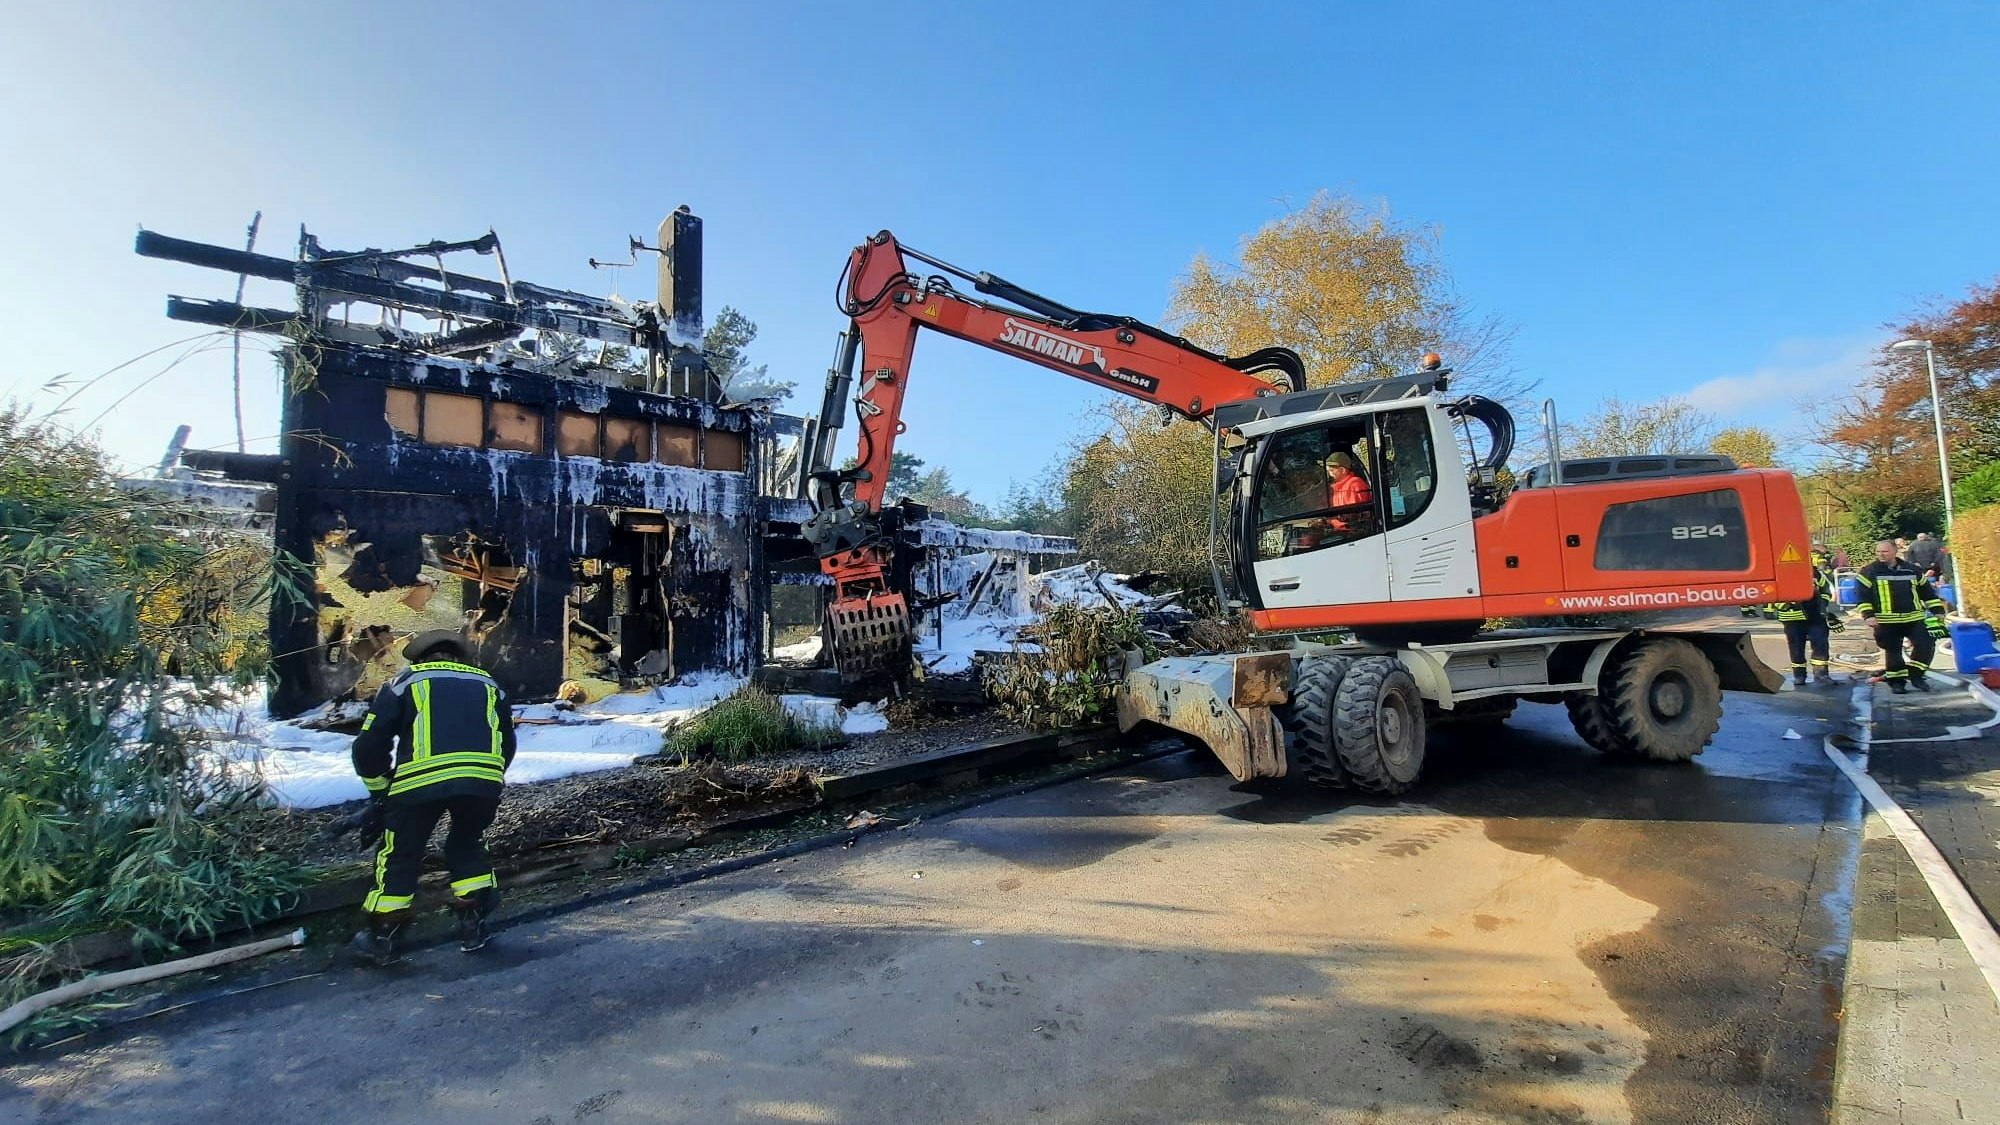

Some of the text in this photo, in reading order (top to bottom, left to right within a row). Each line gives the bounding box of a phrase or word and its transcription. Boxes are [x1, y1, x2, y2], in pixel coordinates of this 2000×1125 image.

[1000, 317, 1150, 388] SALMAN GmbH
[1672, 525, 1727, 540] 924
[1560, 585, 1759, 609] www.salman-bau.de
